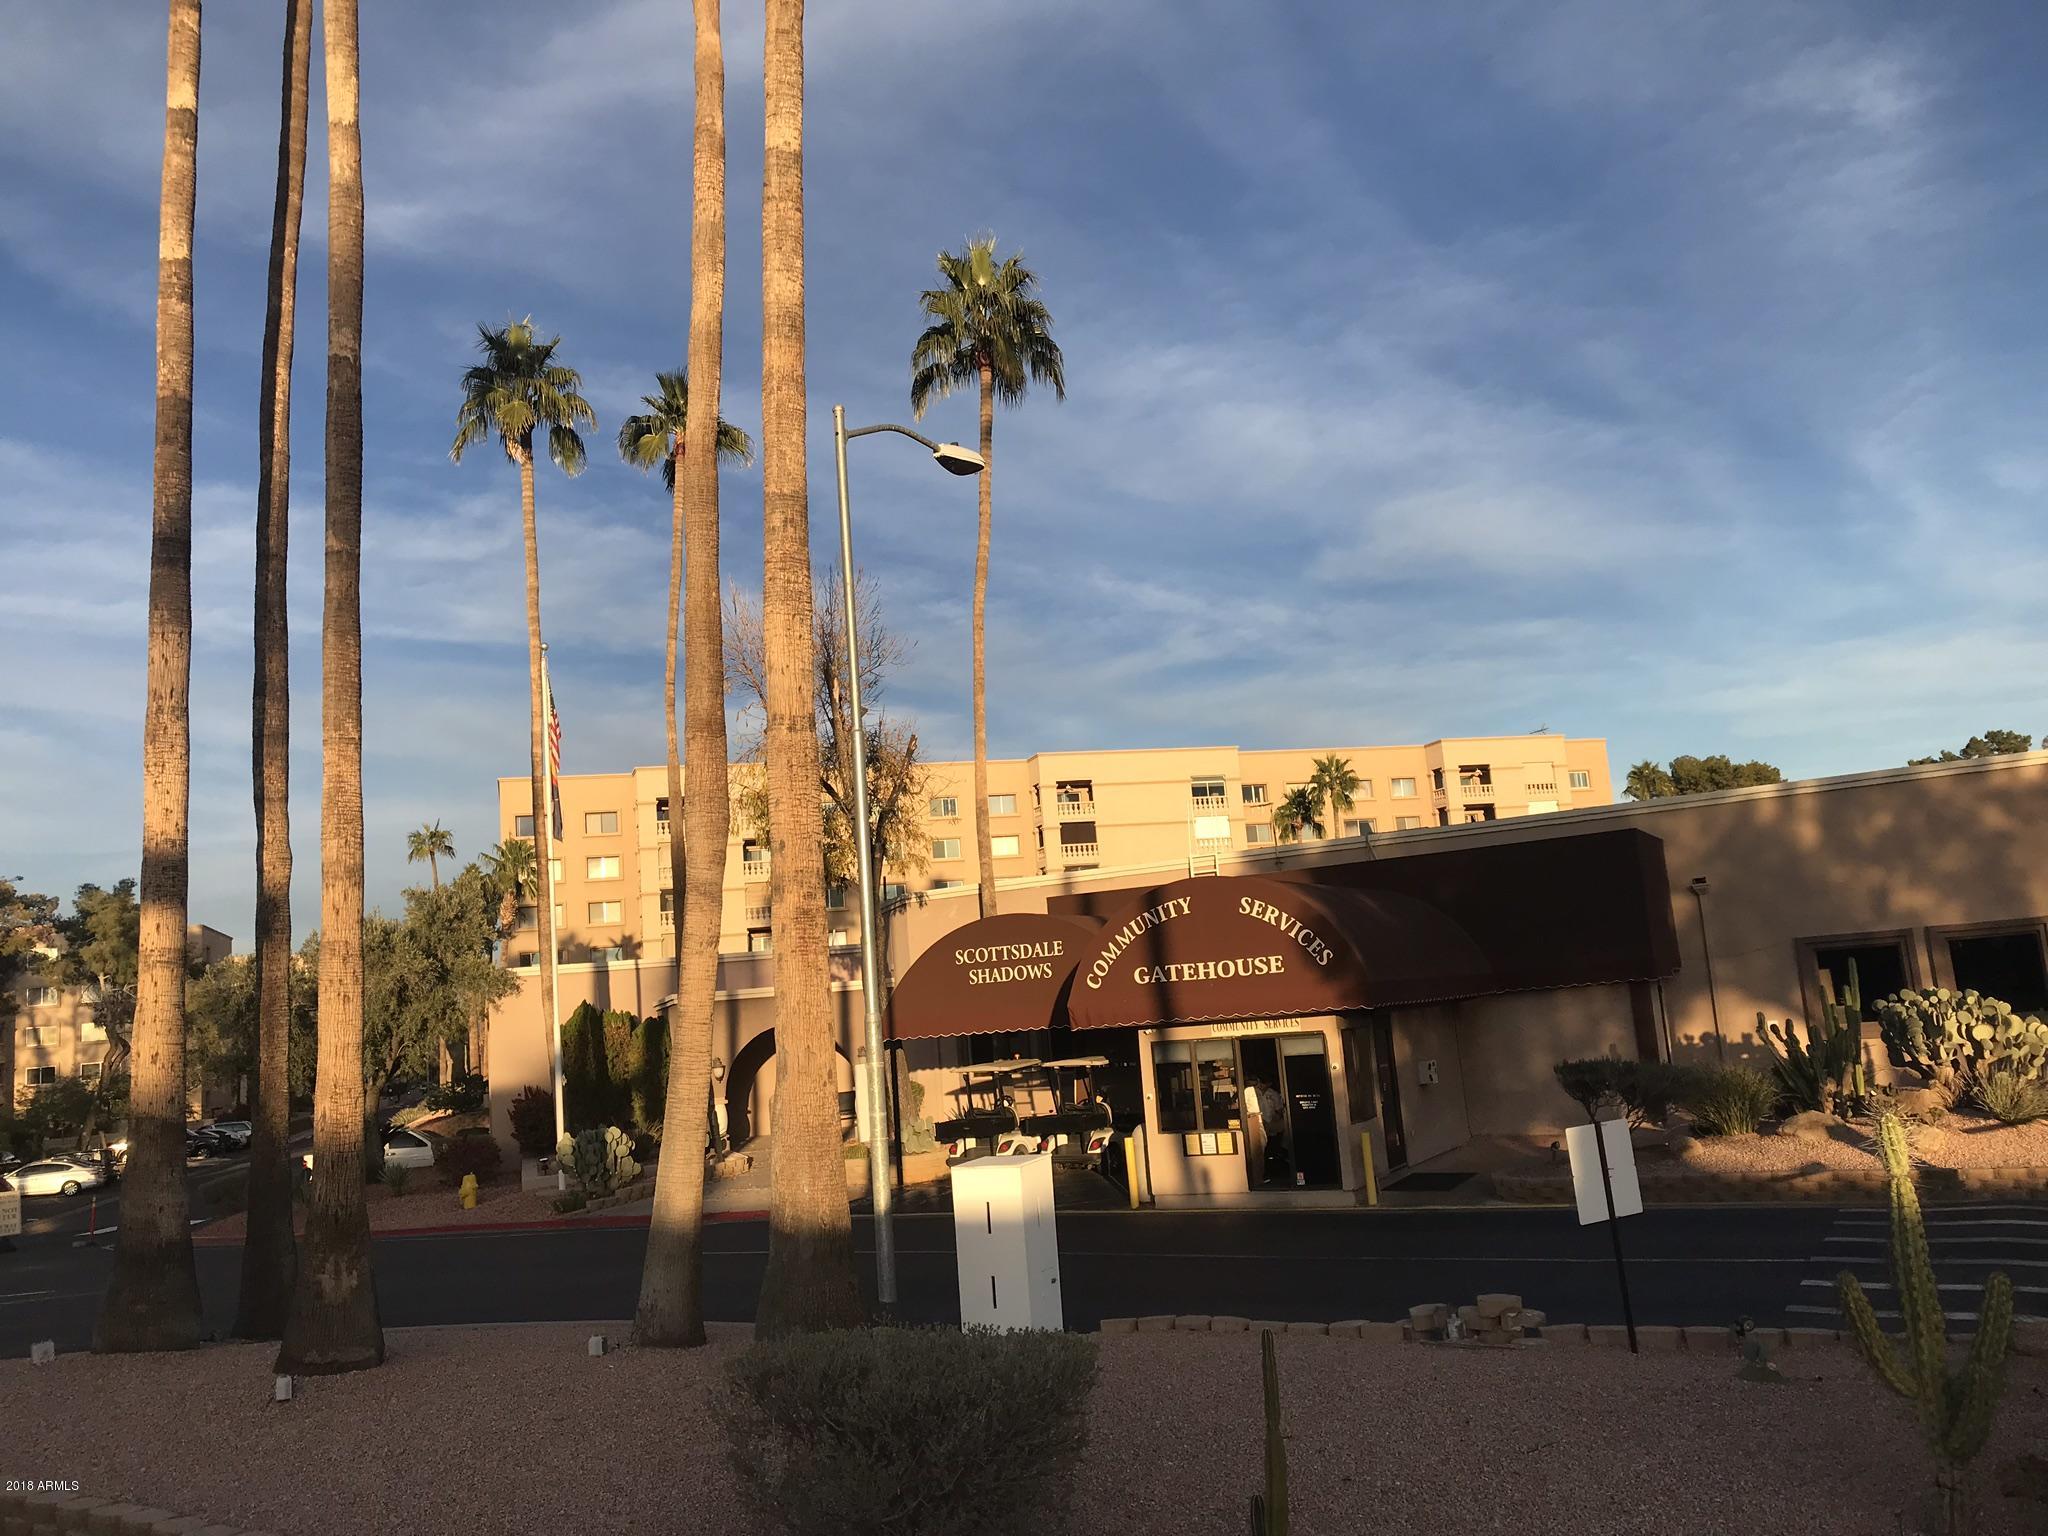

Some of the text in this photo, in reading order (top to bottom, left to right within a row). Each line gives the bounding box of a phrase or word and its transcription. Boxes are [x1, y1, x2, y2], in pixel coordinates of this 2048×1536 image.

[955, 940, 1064, 965] SCOTTSDALE
[1086, 896, 1334, 989] COMMUNITY SERVICES
[968, 962, 1053, 985] SHADOWS
[1133, 955, 1285, 985] GATEHOUSE
[1212, 1018, 1300, 1033] COMMUNITY SERVICES
